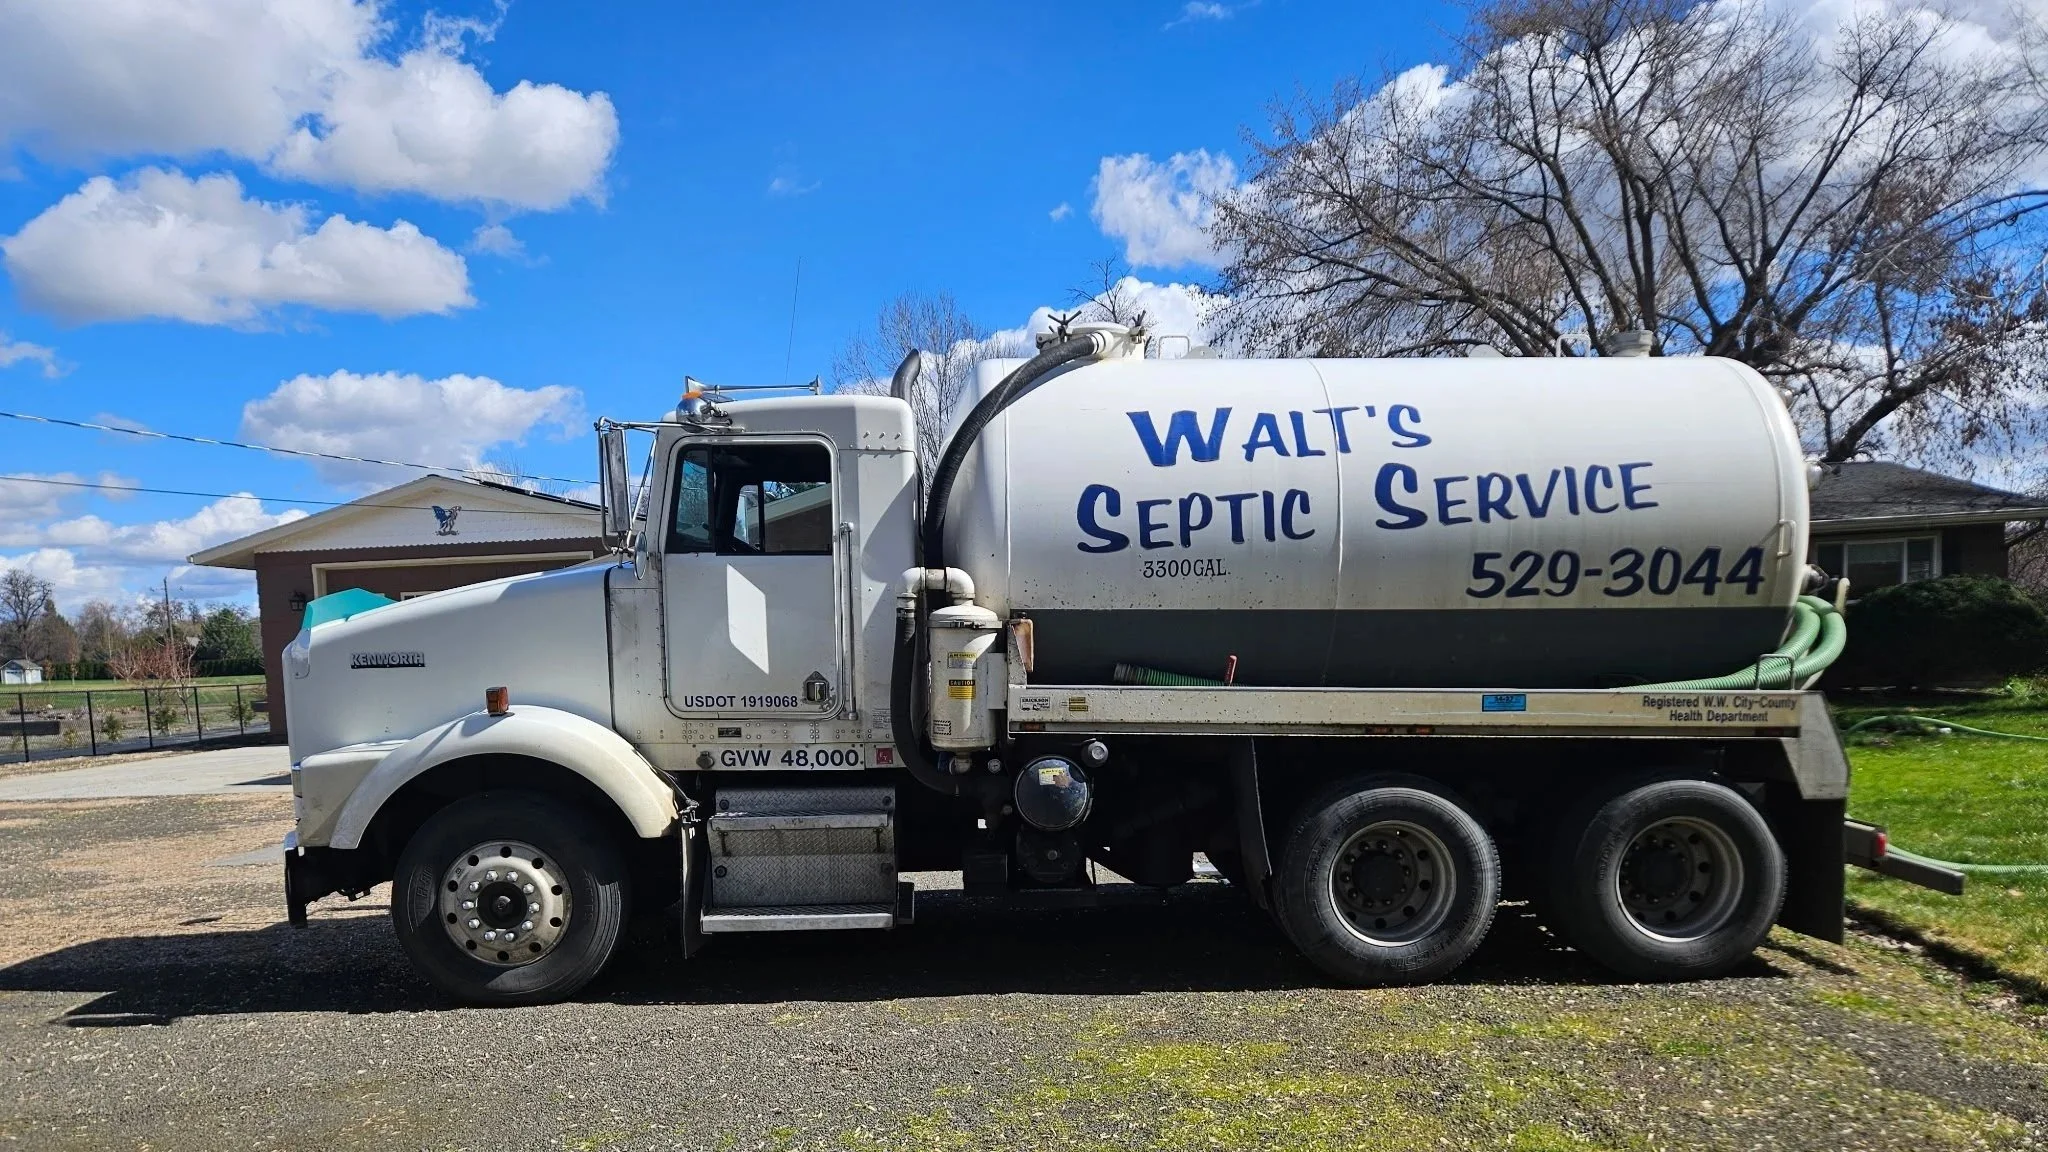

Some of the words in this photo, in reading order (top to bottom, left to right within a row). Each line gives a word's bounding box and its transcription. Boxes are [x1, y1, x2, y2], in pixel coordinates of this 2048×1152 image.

[1126, 404, 1432, 467] WALT'S
[1077, 484, 1316, 553] SEPTIC
[1374, 462, 1660, 530] SERVICE
[1465, 546, 1766, 599] 529-3044
[350, 652, 425, 668] KENWORTH
[684, 695, 736, 708] USDOT
[740, 695, 799, 708] 1919068
[1642, 695, 1700, 710] Registered
[1703, 695, 1729, 708] W.W.
[1732, 695, 1798, 711] City-County
[1669, 709, 1703, 722] Health
[1706, 710, 1769, 724] Department
[720, 749, 772, 767] GVW
